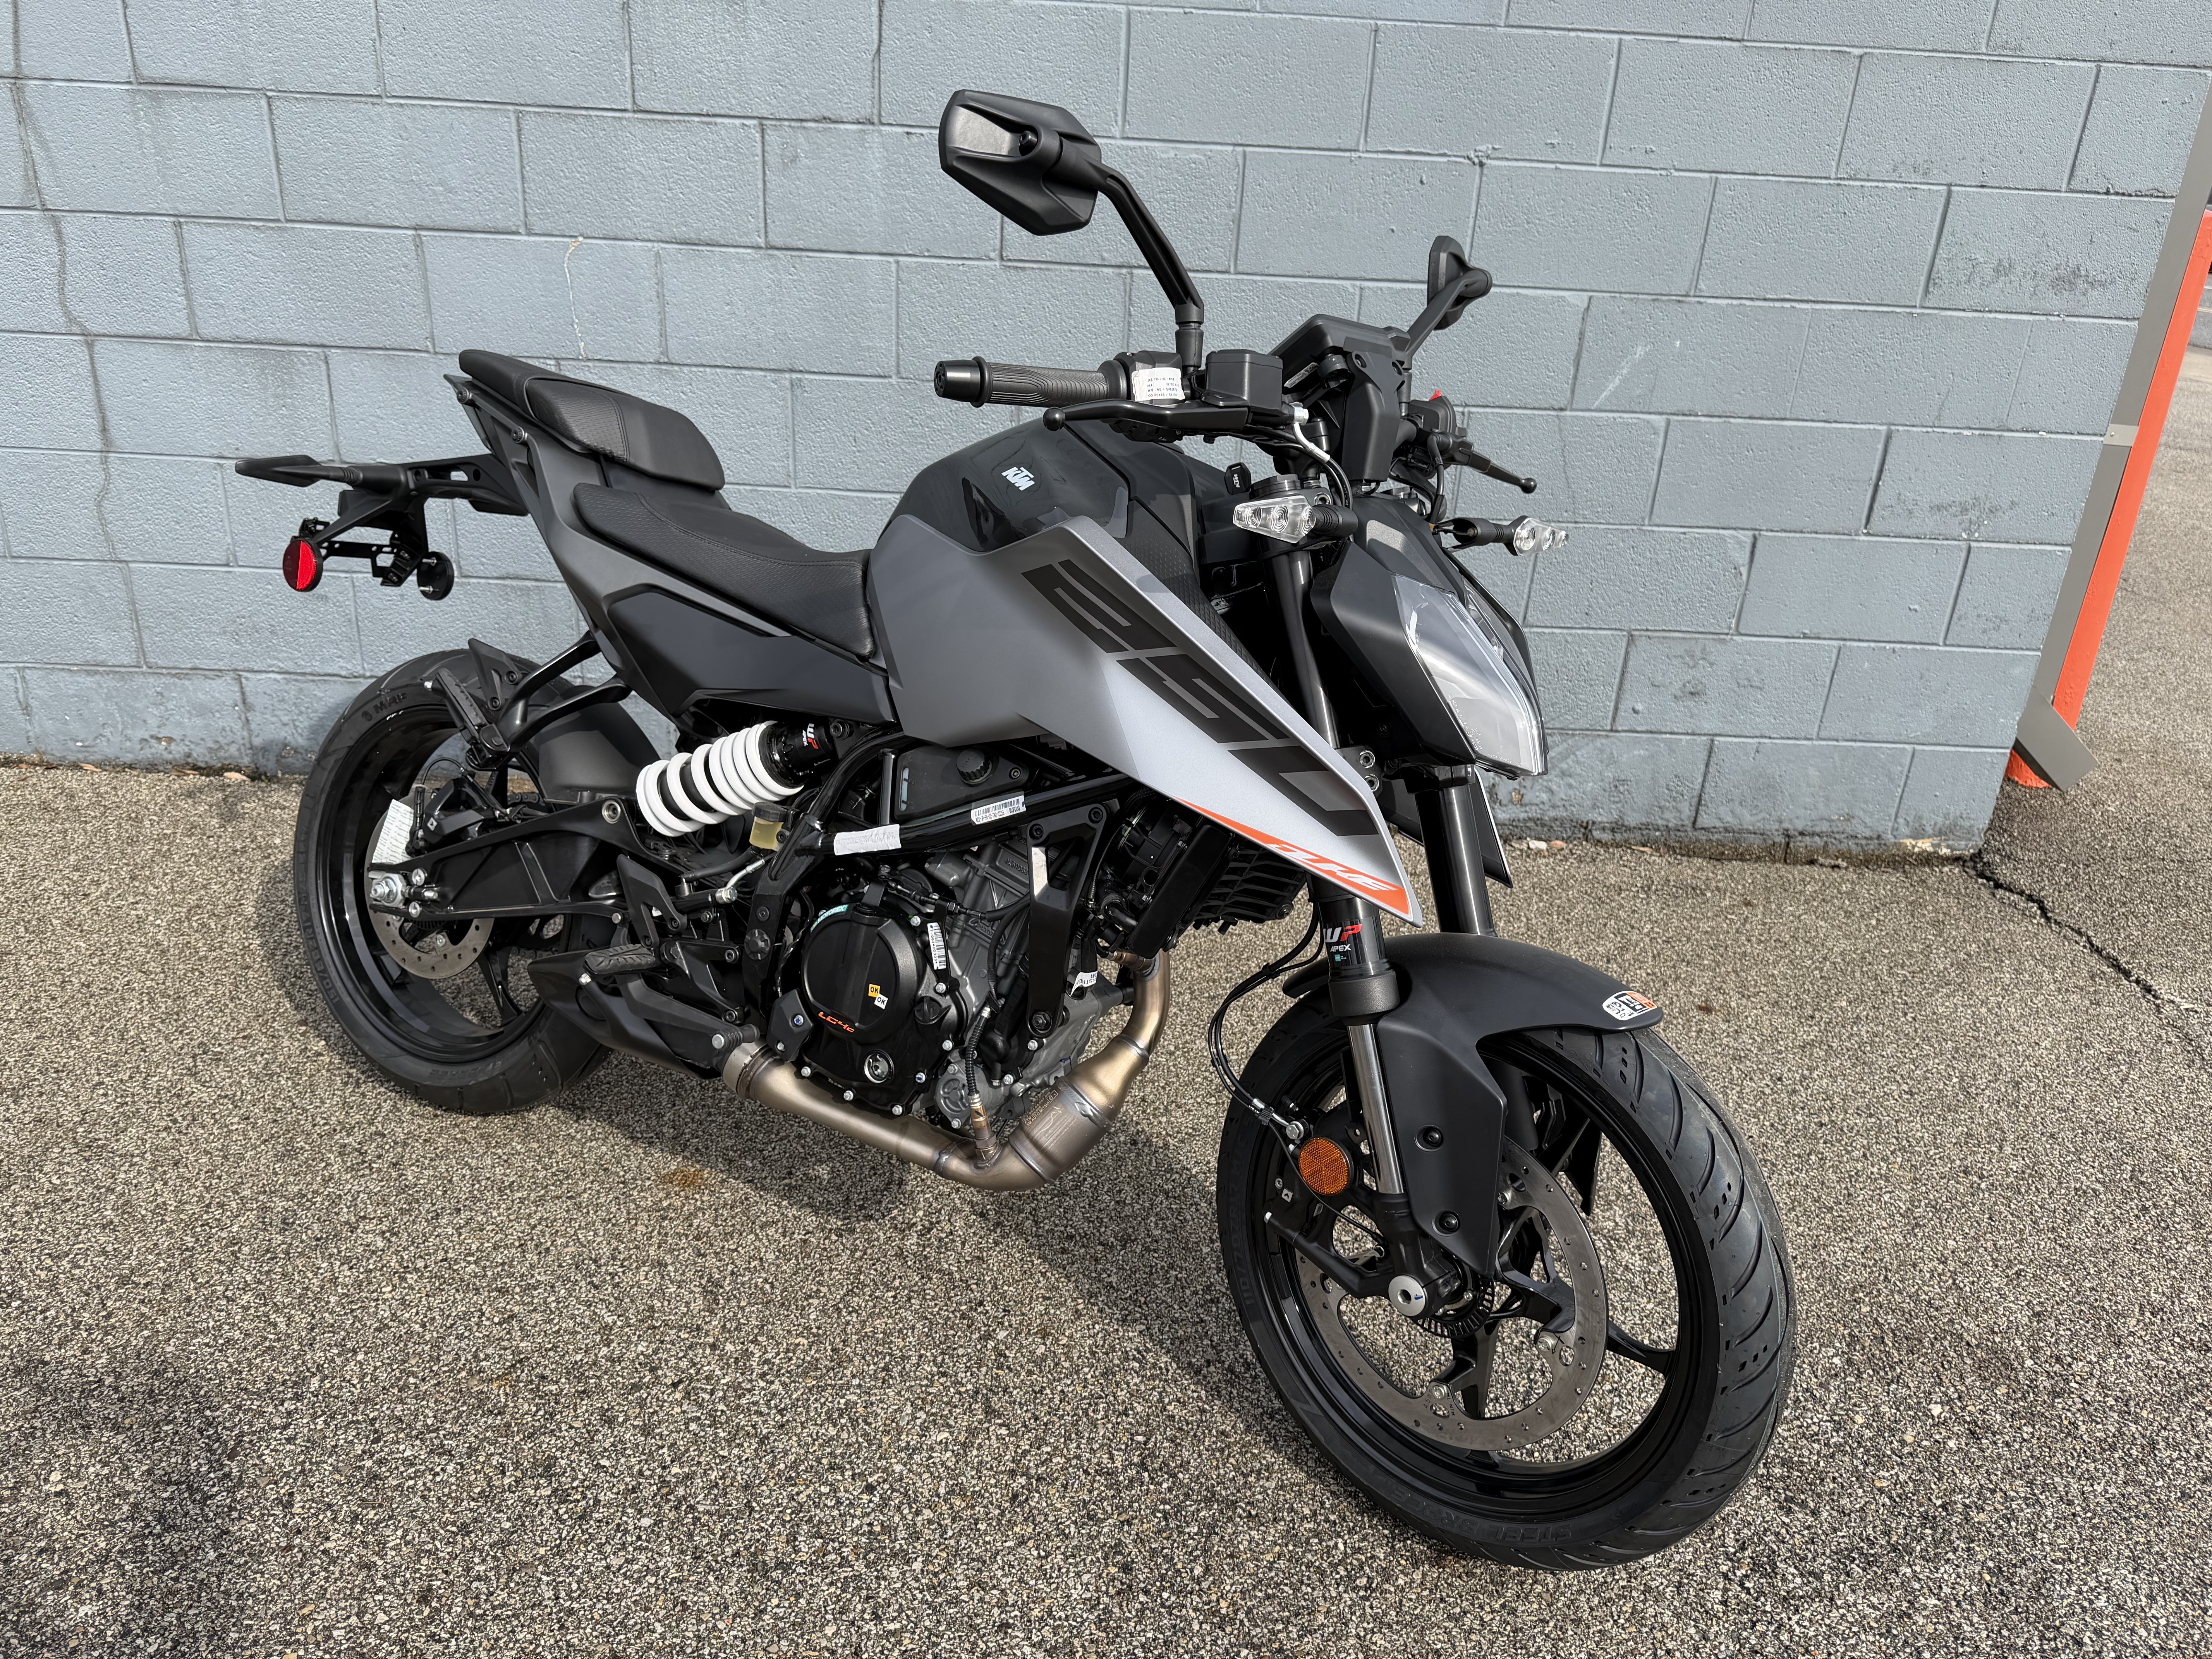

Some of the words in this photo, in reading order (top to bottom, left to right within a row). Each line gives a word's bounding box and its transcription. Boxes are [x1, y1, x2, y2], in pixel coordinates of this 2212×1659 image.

[1001, 467, 1035, 491] KTM
[807, 723, 819, 749] WP
[1266, 843, 1399, 891] DUKE
[817, 904, 848, 923] MOTOREX
[1323, 924, 1363, 943] WP
[1330, 944, 1352, 952] APEX
[877, 997, 886, 1005] OK
[1391, 1487, 1480, 1535] BRACE
[1489, 1524, 1572, 1542] STEEL
